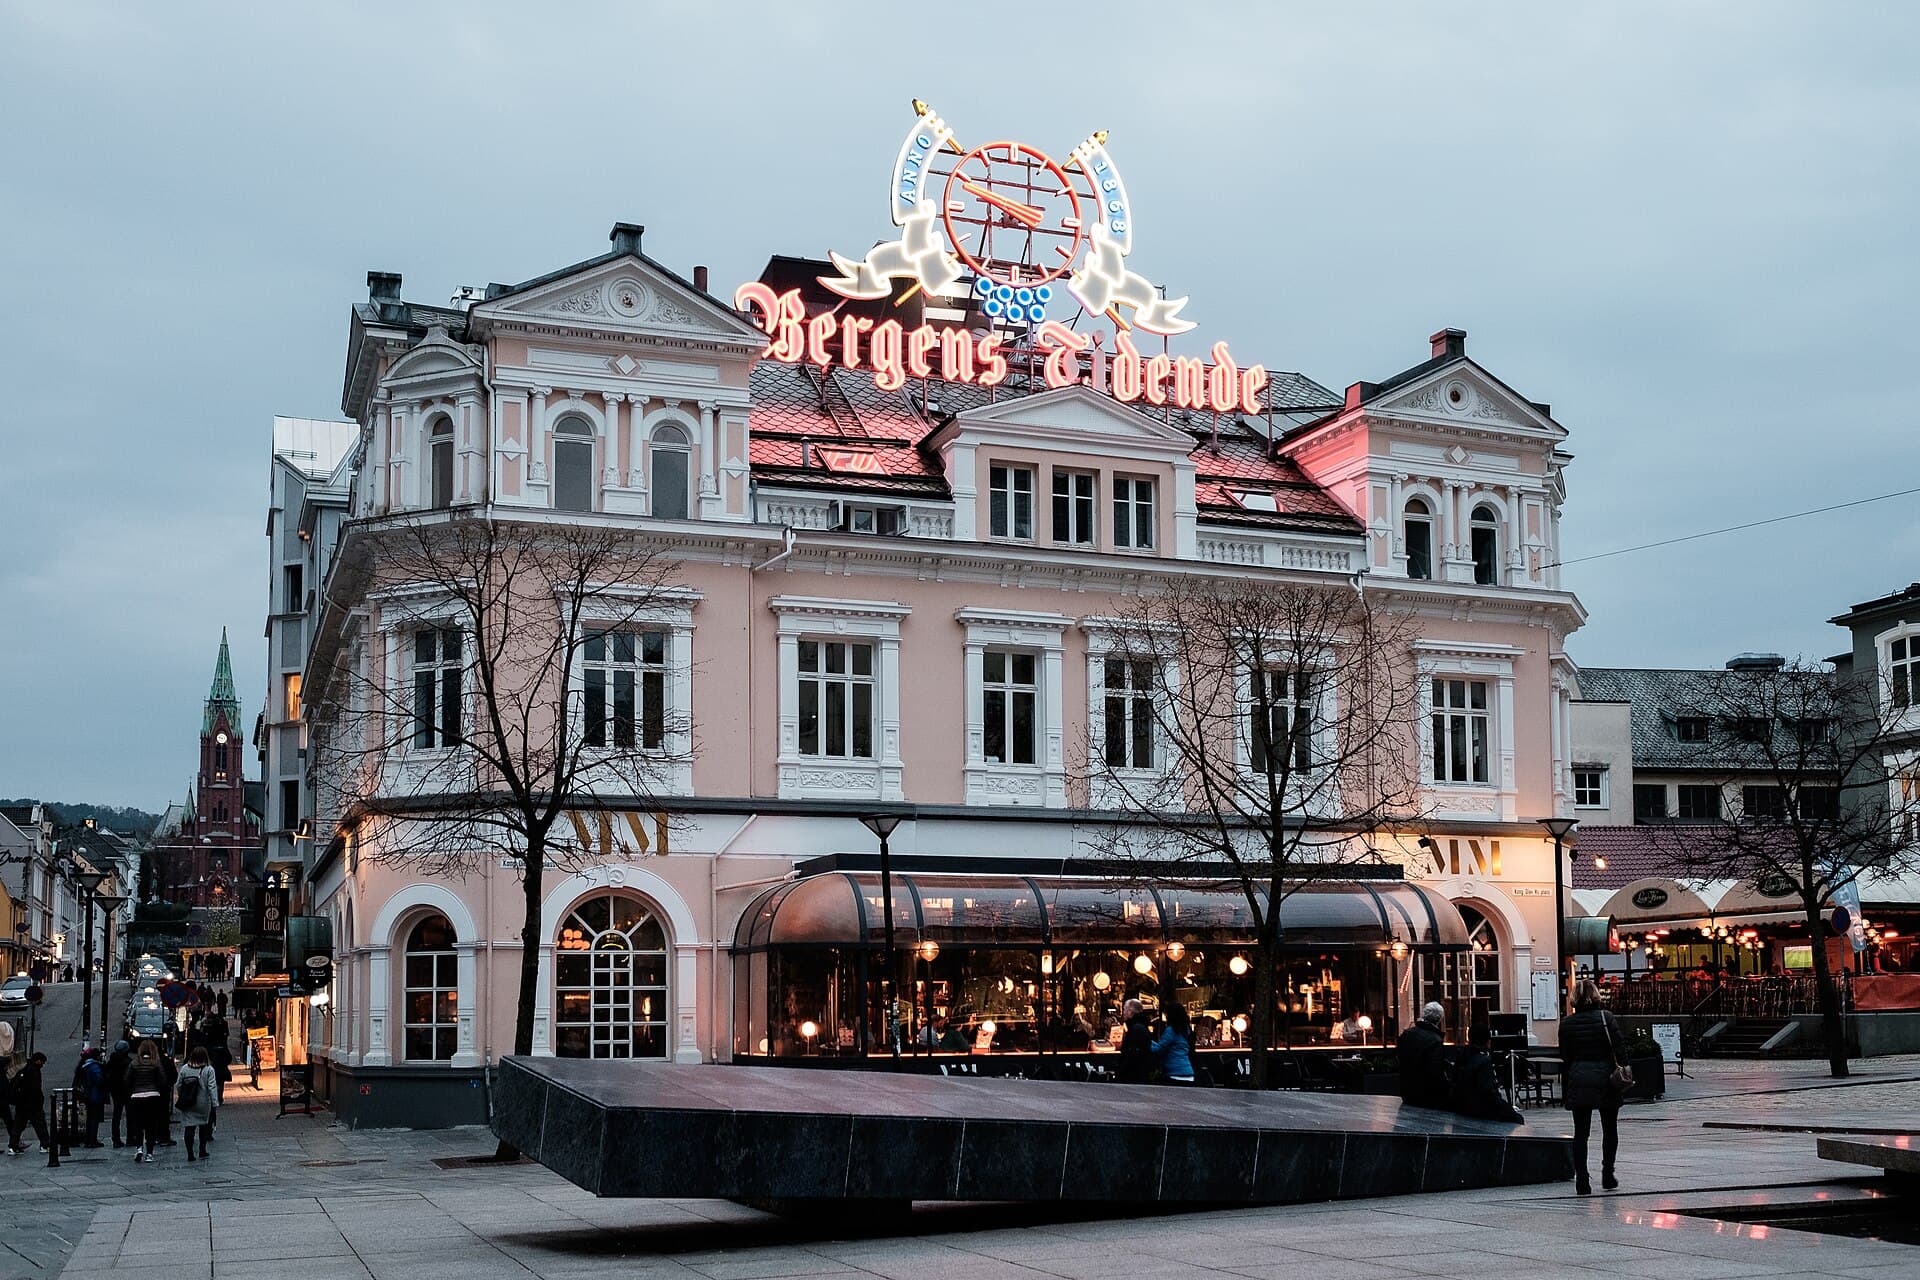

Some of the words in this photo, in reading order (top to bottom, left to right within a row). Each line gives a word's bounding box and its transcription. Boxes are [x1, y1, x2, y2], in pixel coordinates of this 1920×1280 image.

[899, 134, 931, 205] ANNO
[1093, 161, 1127, 233] 1868
[733, 281, 1008, 392] Bergens
[1036, 320, 1269, 414] Tidende
[263, 918, 281, 932] Luca
[264, 891, 281, 906] Deli
